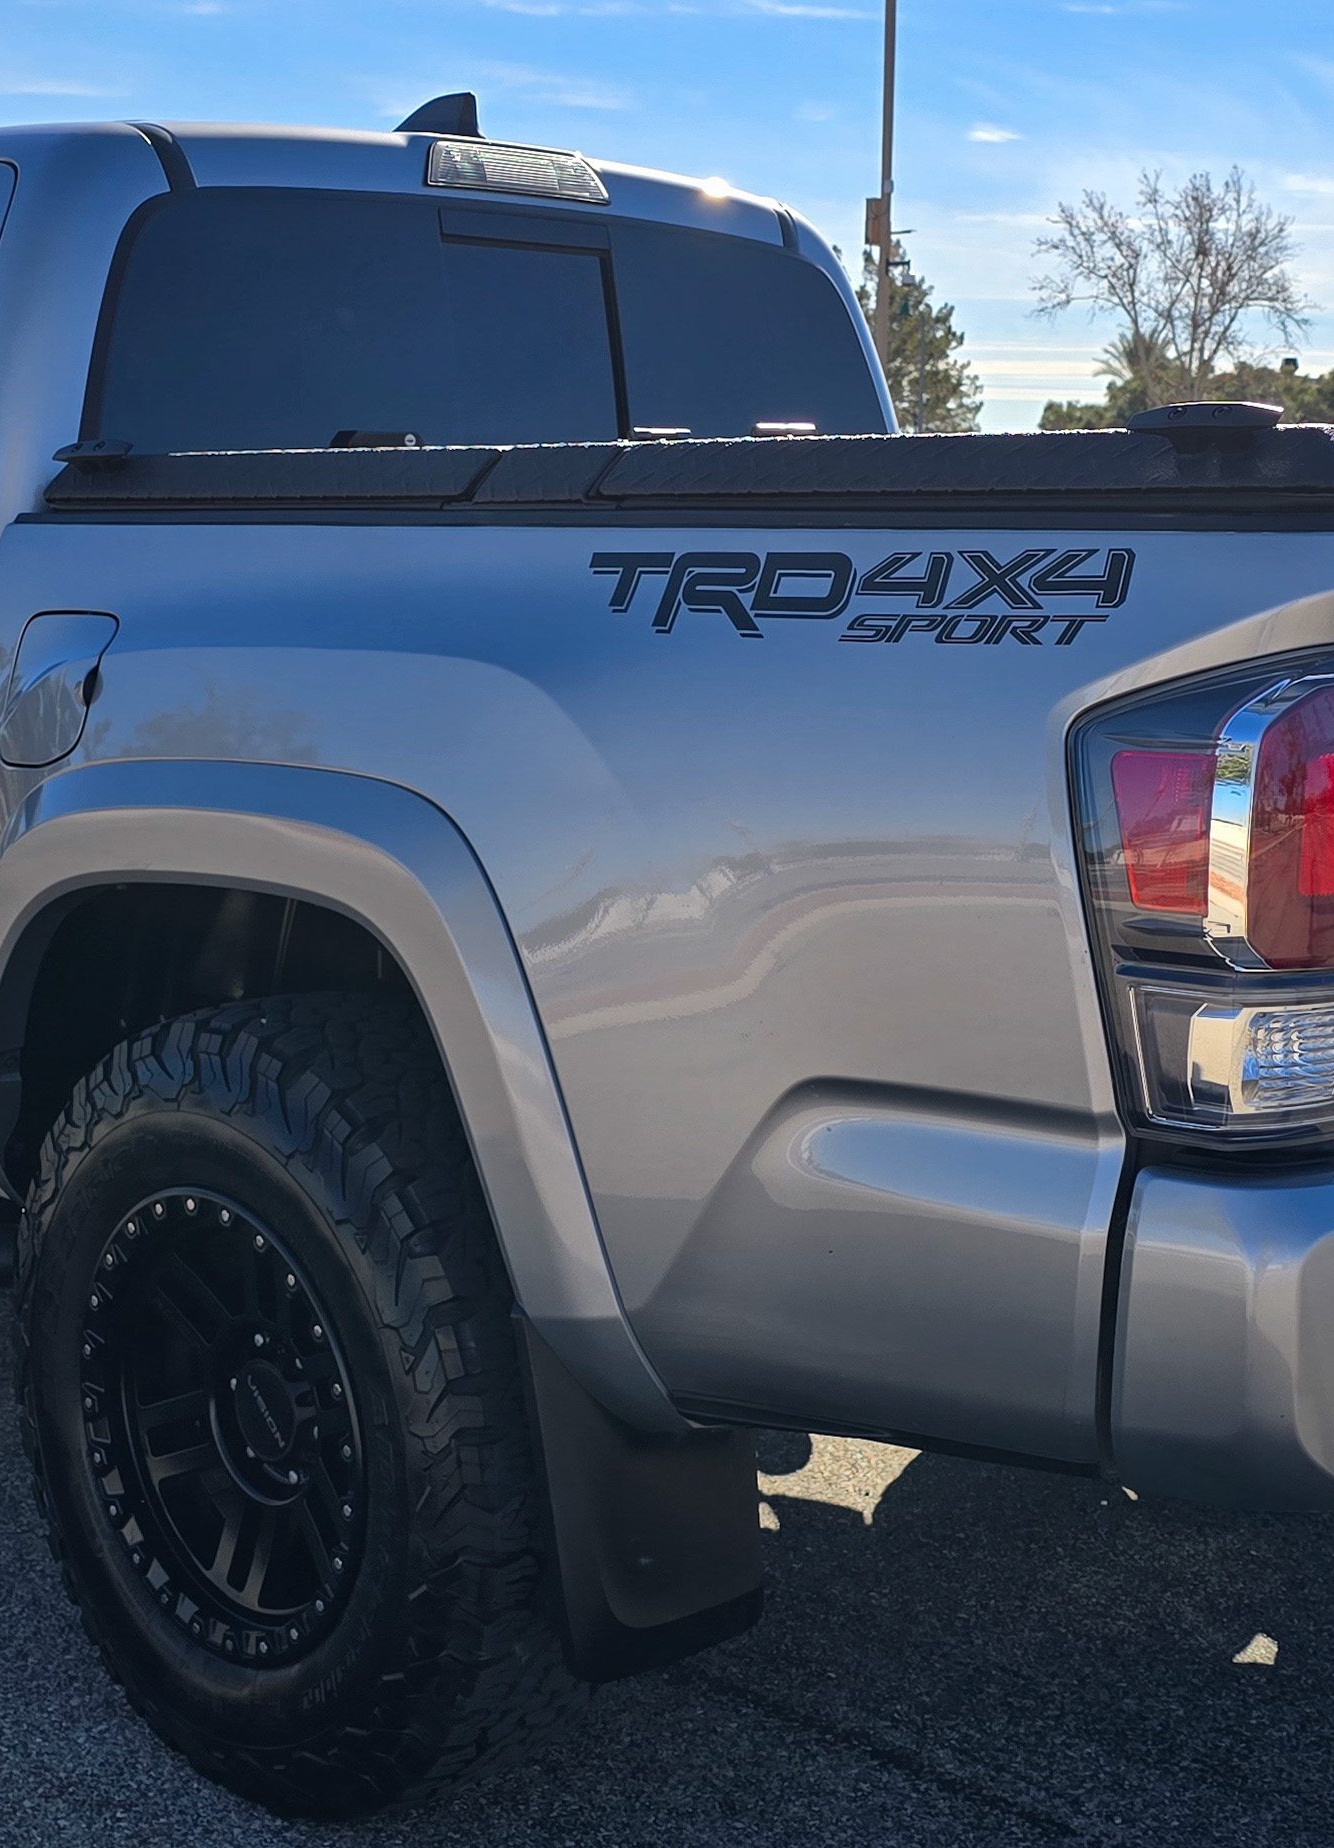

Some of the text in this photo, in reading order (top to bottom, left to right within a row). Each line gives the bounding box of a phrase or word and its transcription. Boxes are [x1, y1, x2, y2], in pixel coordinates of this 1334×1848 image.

[589, 548, 1137, 638] TRD 4X4
[838, 613, 1109, 646] SPORT
[247, 1374, 287, 1449] VISION
